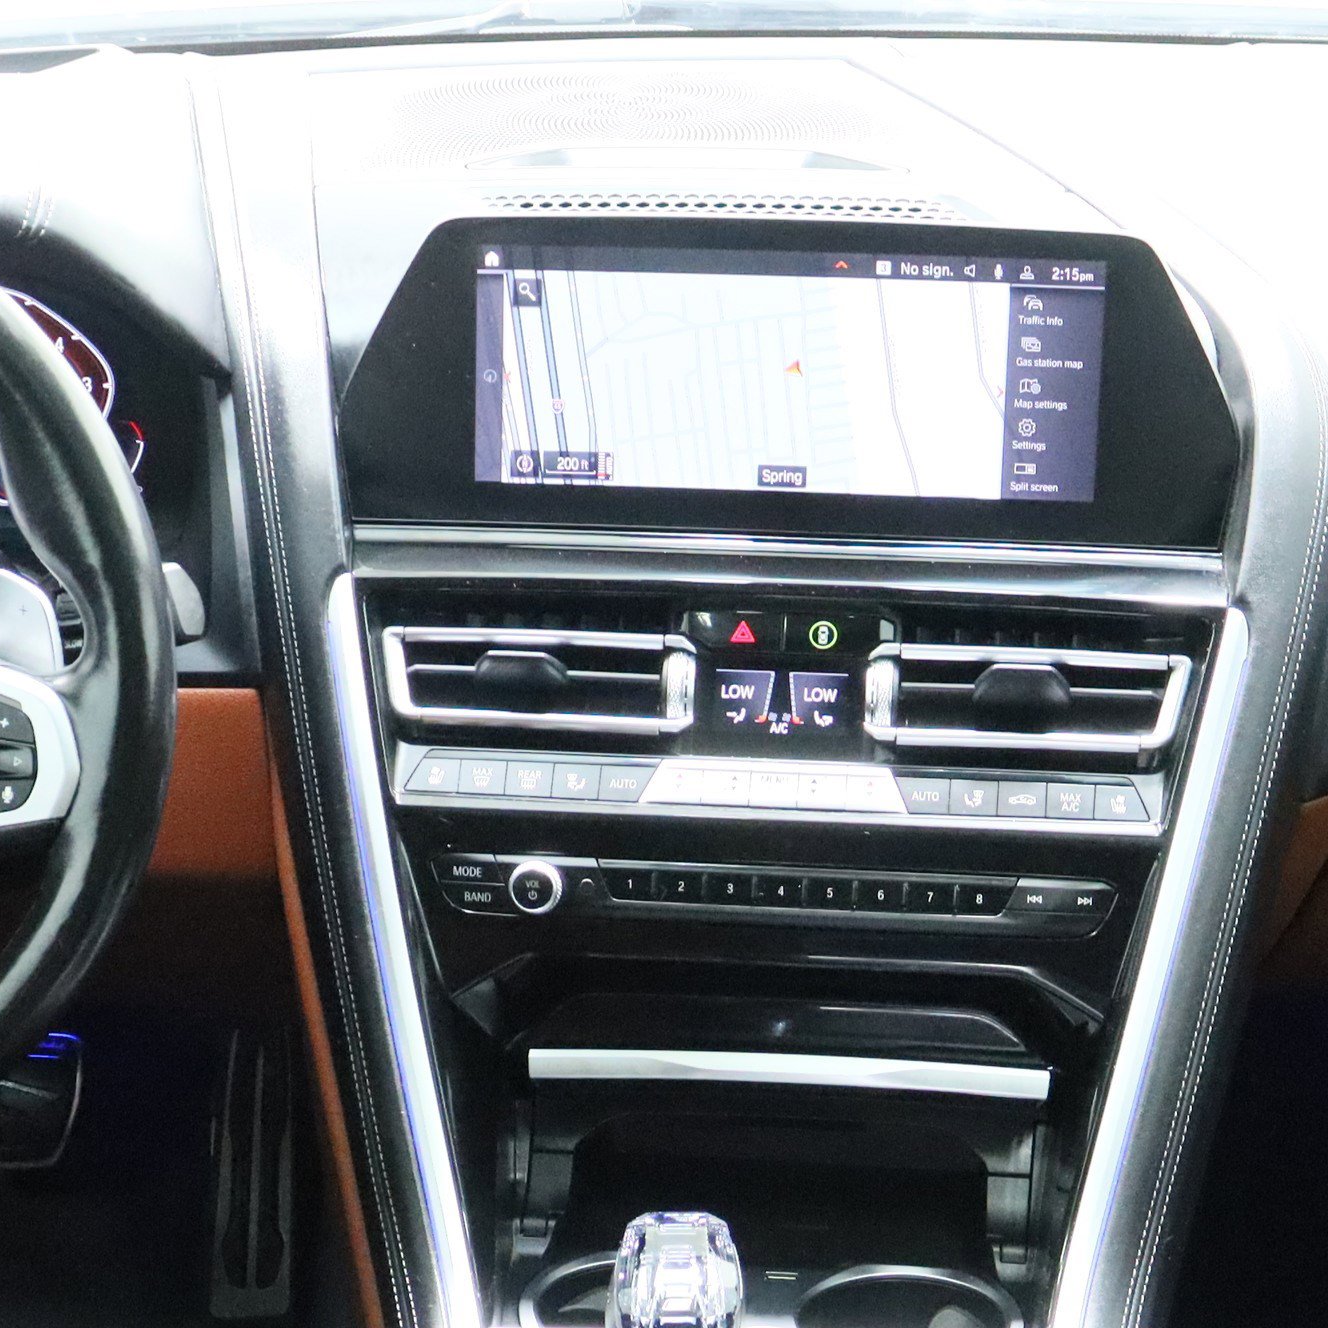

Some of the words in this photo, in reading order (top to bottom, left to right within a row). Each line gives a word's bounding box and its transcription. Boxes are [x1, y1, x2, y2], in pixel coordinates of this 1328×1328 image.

[900, 262, 919, 276] No
[922, 262, 954, 278] sign.
[1052, 267, 1094, 282] 2:15pm
[1018, 315, 1045, 326] Traffic
[55, 337, 64, 353] 4
[1016, 357, 1032, 367] Gas
[1034, 358, 1062, 368] station
[1064, 360, 1083, 369] map
[82, 377, 92, 392] 3
[1014, 398, 1032, 409] Map
[1034, 400, 1067, 411] settings
[1012, 440, 1046, 452] Settings
[557, 456, 579, 470] 200
[580, 460, 589, 470] ft
[762, 469, 802, 484] Spring
[1010, 481, 1028, 492] Split
[1031, 484, 1058, 492] screen
[721, 684, 755, 700] LOW
[803, 687, 838, 703] LOW
[769, 722, 789, 735] A/C
[472, 767, 493, 776] MAX
[518, 770, 542, 780] REAR
[609, 778, 638, 789] AUTO
[912, 791, 940, 802] AUTO
[1060, 793, 1081, 803] MAX
[1061, 802, 1080, 812] A/C
[453, 866, 483, 878] MODE
[525, 879, 540, 889] VOL
[627, 879, 633, 890] 1
[678, 881, 685, 892] 2
[726, 883, 734, 894] 3
[464, 891, 492, 902] BAND
[777, 886, 785, 896] 4
[826, 888, 834, 898] 5
[877, 890, 885, 901] 6
[927, 891, 934, 902] 7
[975, 894, 983, 905] 8
